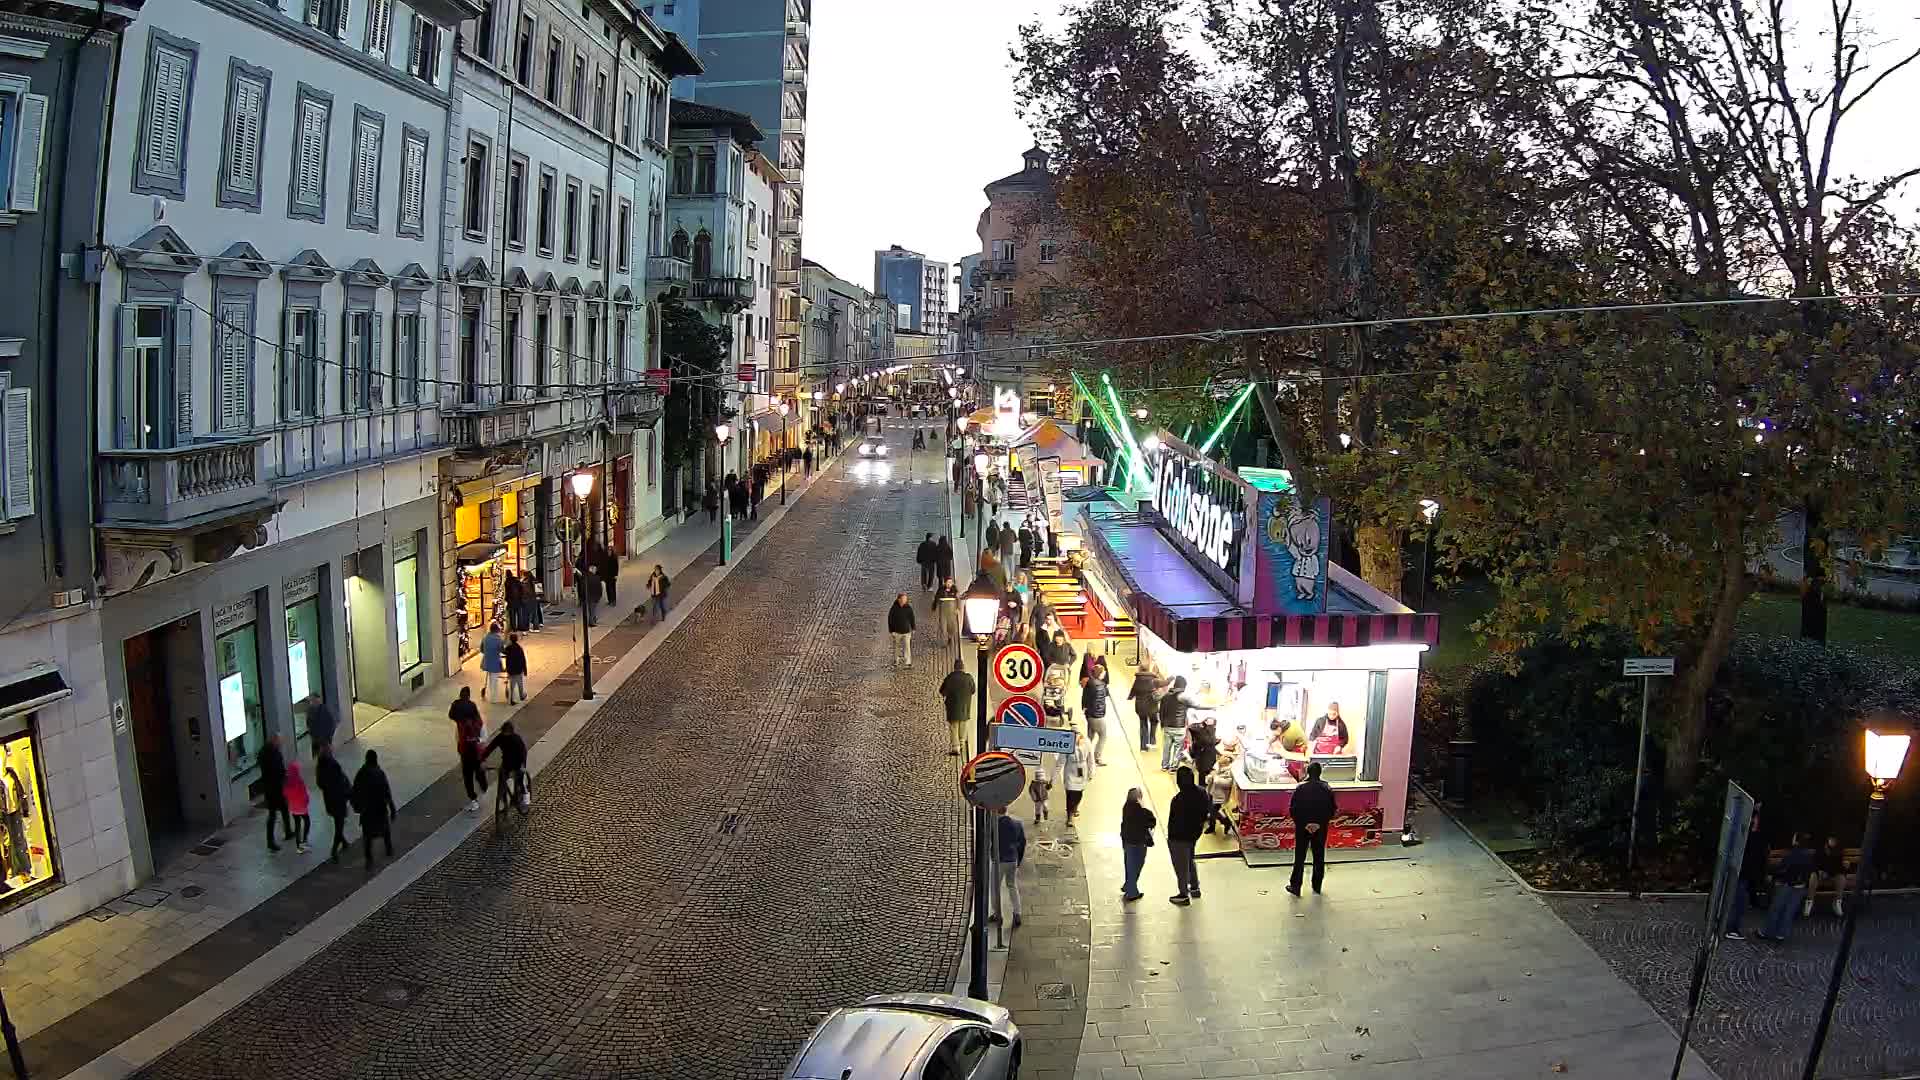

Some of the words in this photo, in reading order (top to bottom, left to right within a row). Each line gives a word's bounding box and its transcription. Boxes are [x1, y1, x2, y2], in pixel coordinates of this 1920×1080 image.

[1005, 658, 1033, 679] 30
[1038, 737, 1070, 749] Dante
[1330, 814, 1377, 828] Calde
